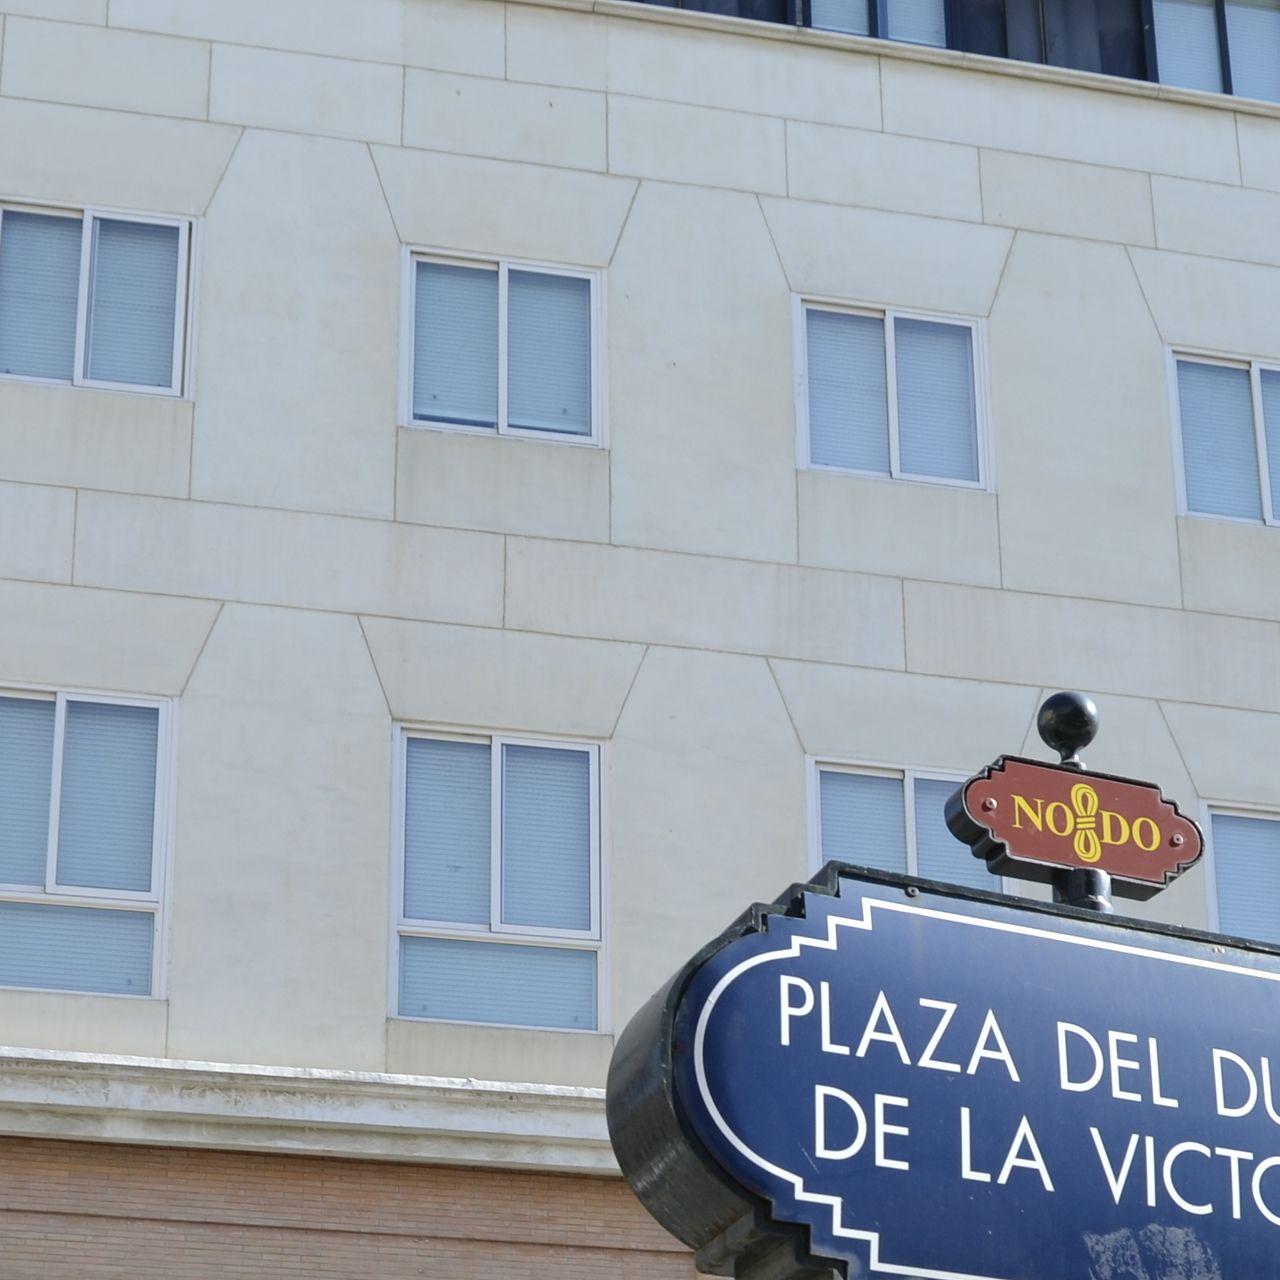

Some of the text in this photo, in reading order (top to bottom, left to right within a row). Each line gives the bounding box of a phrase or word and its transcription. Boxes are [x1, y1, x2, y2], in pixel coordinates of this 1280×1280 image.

[778, 974, 1020, 1083] PLAZA
[1056, 1022, 1179, 1109] DEL
[814, 1085, 909, 1171] DE
[959, 1105, 1055, 1193] LA
